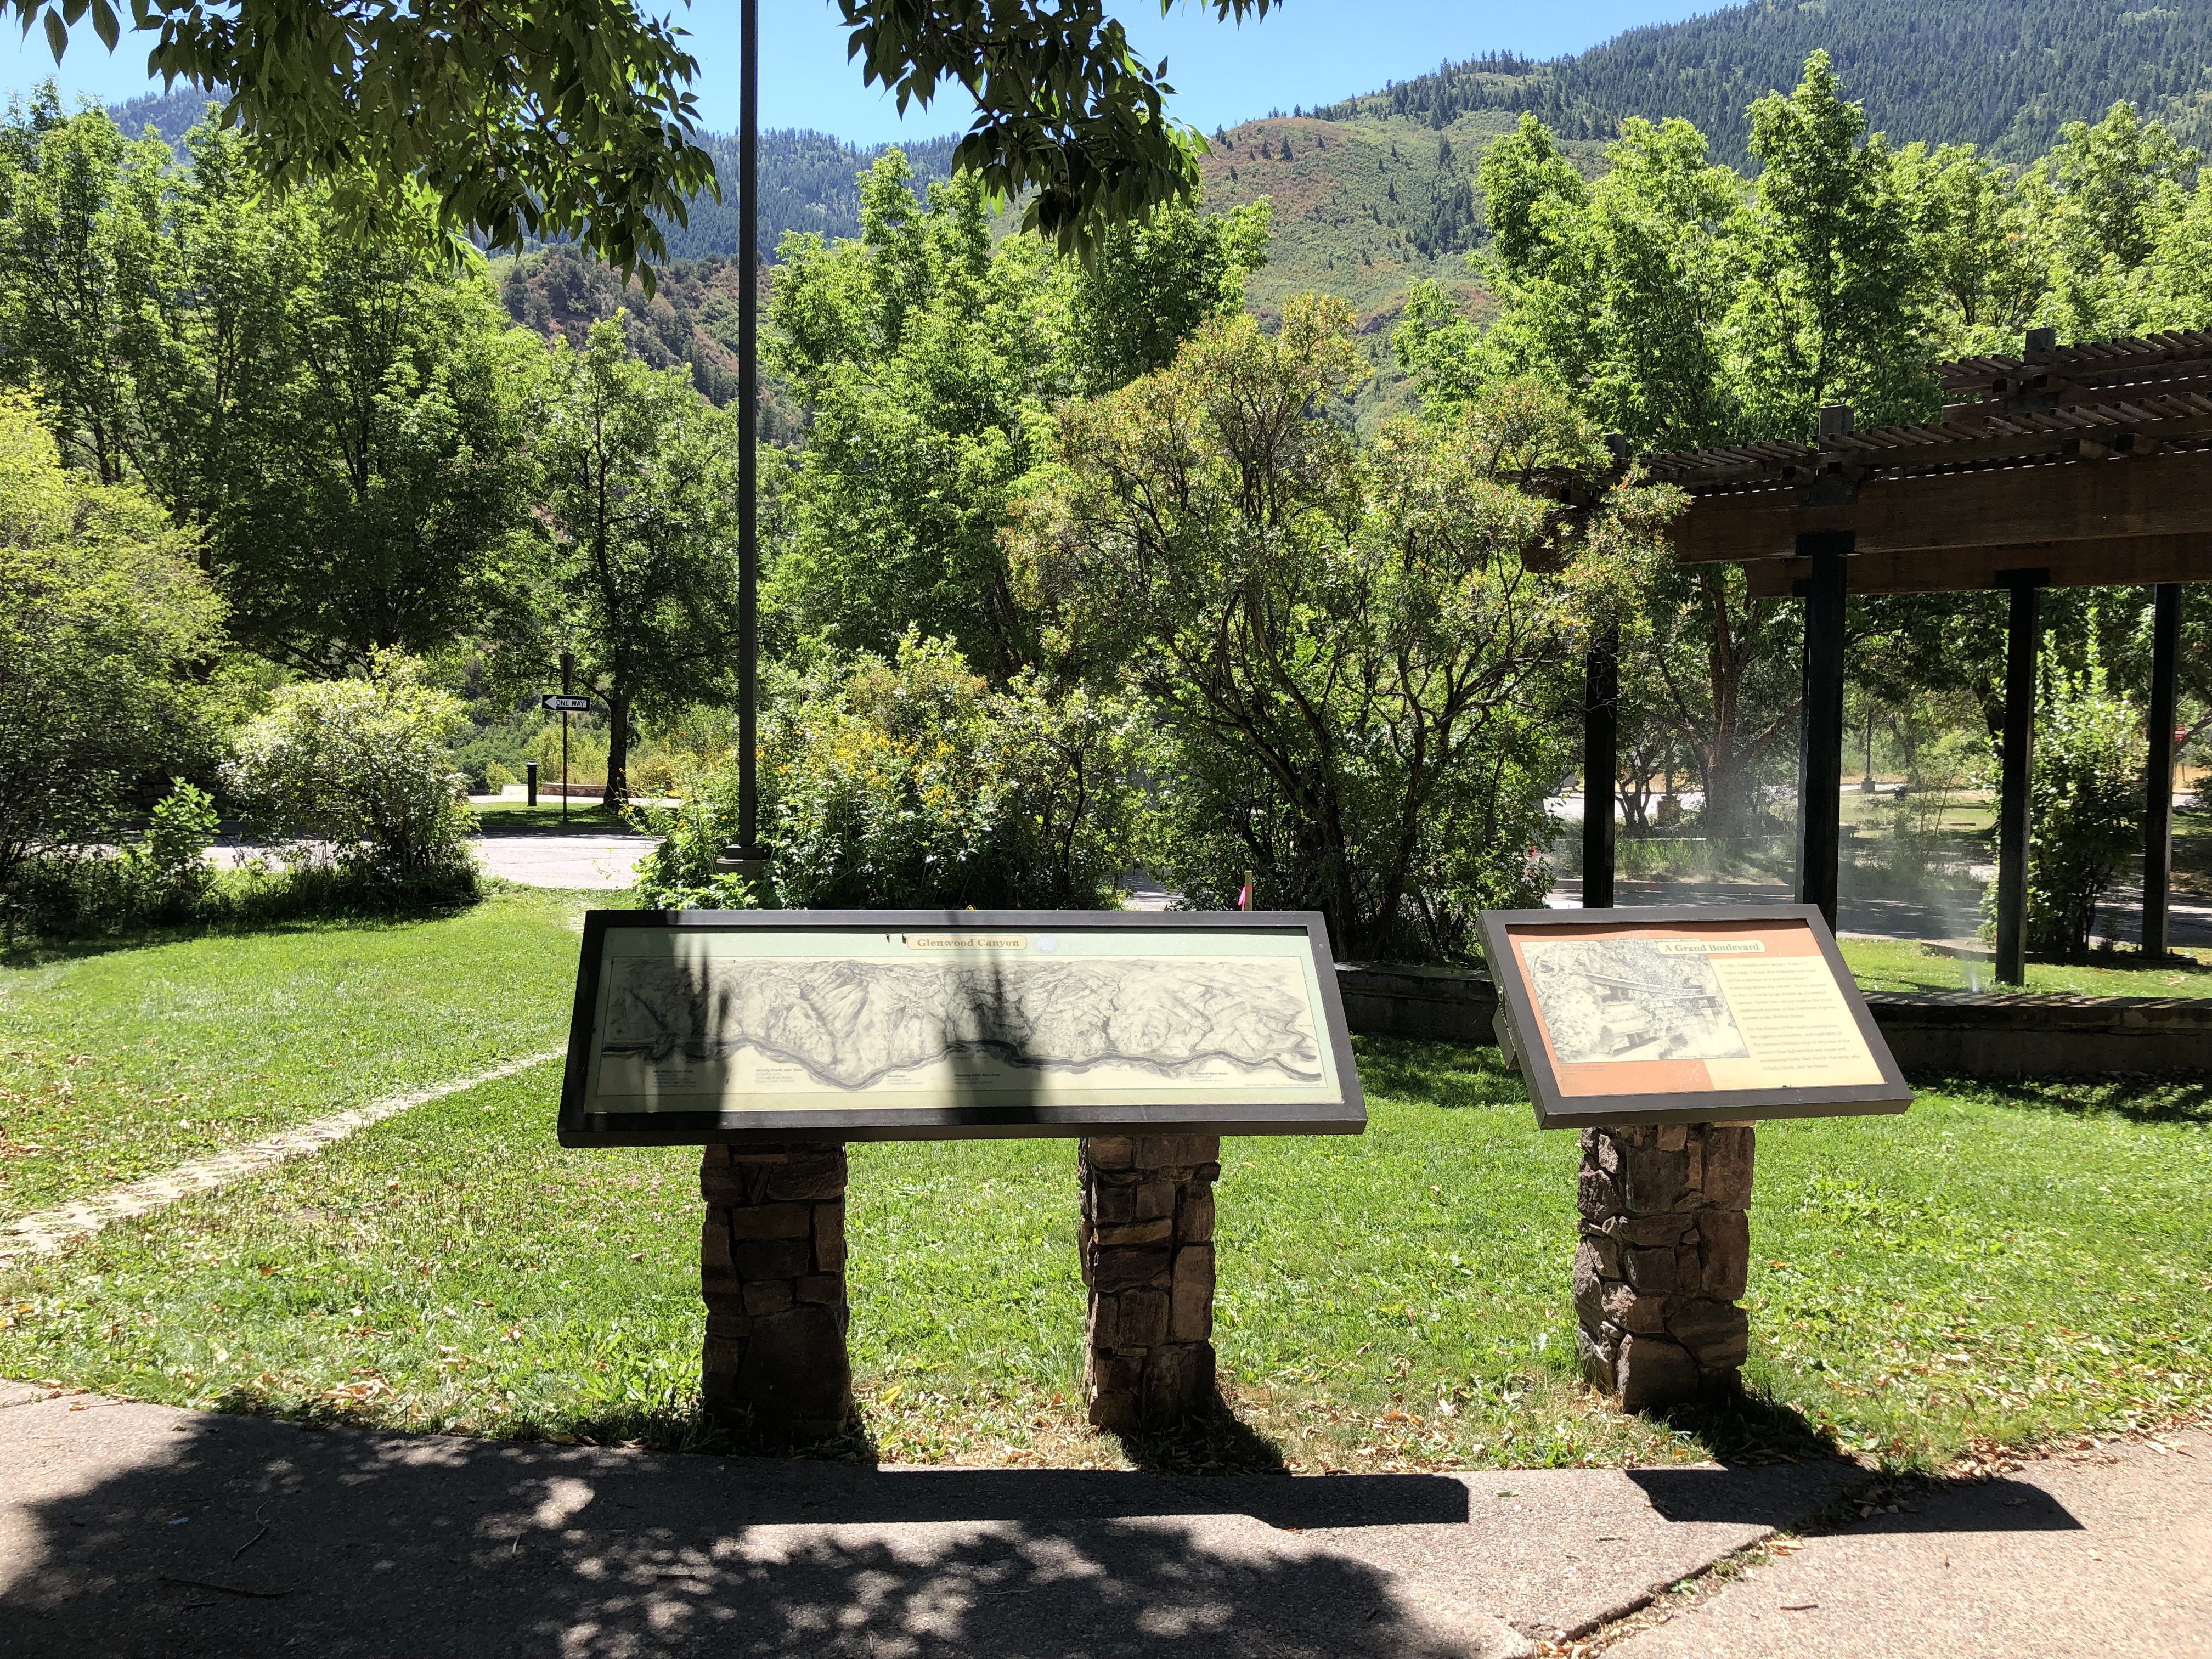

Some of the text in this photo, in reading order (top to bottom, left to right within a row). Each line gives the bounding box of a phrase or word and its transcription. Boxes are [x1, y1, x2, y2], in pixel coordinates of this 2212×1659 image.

[978, 939, 1019, 948] Canyon
[1665, 944, 1673, 952] A
[1708, 943, 1760, 951] Boulevard
